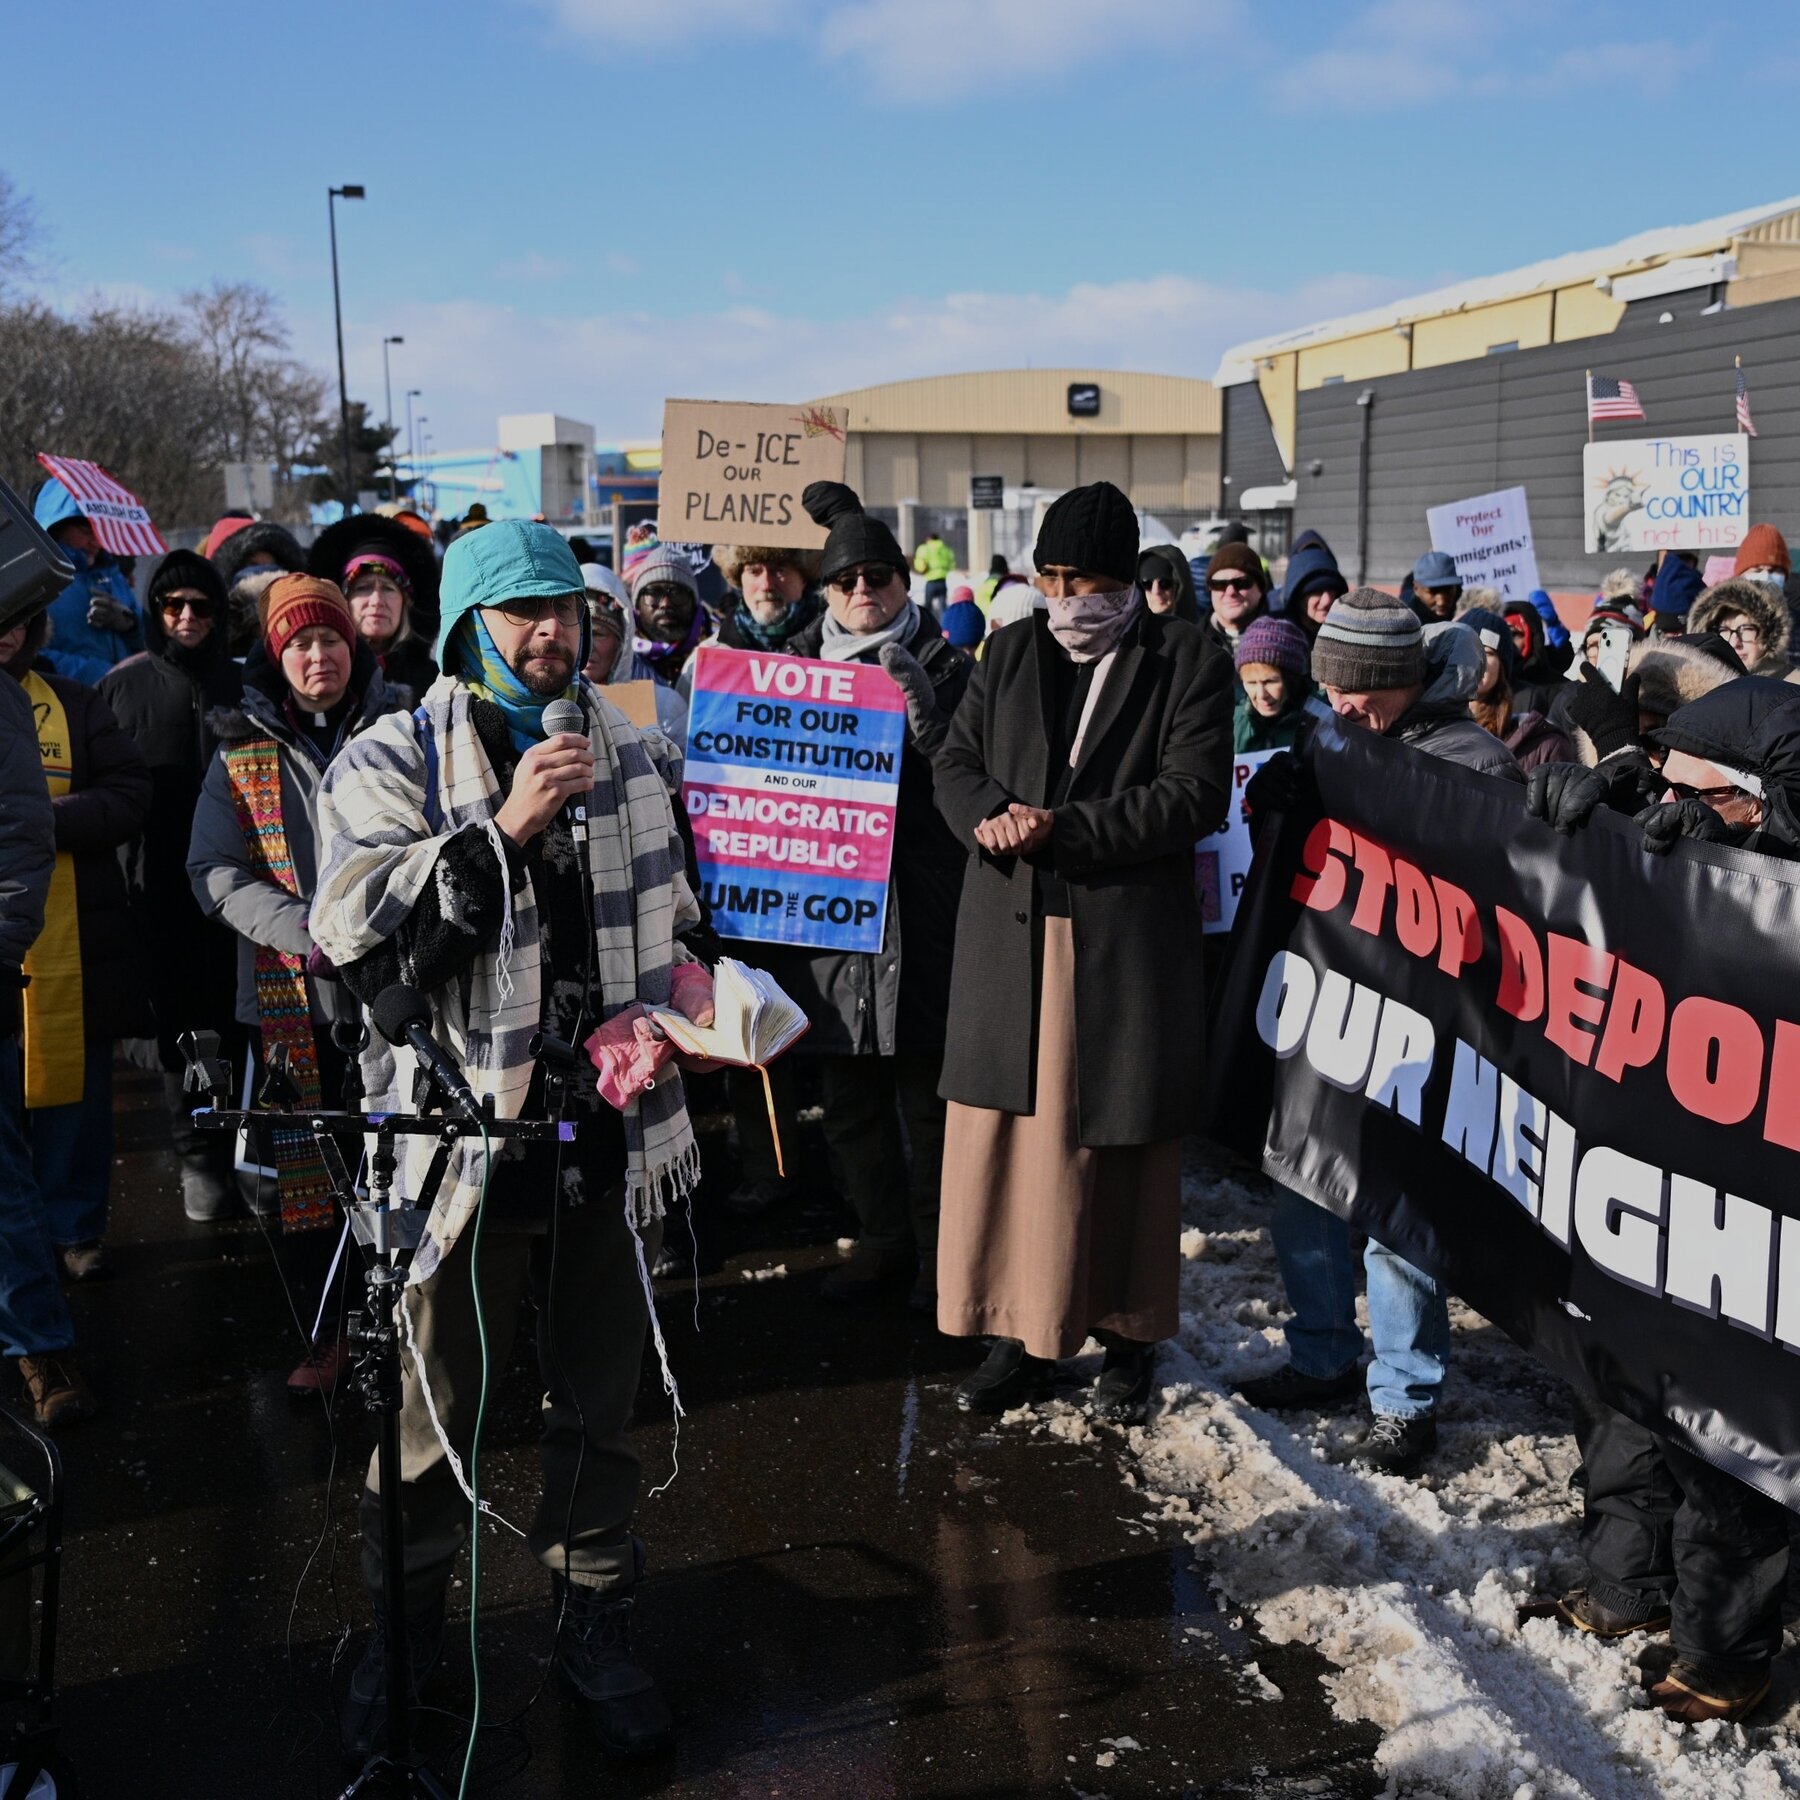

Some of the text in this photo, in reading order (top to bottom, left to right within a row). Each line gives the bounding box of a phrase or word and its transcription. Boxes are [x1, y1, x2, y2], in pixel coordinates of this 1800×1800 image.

[696, 429, 802, 466] De-ICE
[1646, 442, 1700, 467] This
[723, 465, 761, 481] OUR
[1680, 464, 1740, 491] OUR
[85, 502, 145, 521] ABOLISH ICE
[685, 491, 794, 525] PLANES
[1456, 507, 1502, 527] Protect
[1646, 489, 1749, 519] COUNTRY
[1471, 524, 1495, 537] Our
[1643, 521, 1737, 547] not his
[1493, 564, 1517, 579] Just
[749, 658, 855, 702] VOTE
[736, 701, 859, 735] FOR OUR
[693, 731, 894, 774] CONSTITUTION
[764, 774, 817, 790] AND OUR
[687, 790, 889, 837] DEMOCRATIC
[708, 829, 859, 870] REPUBLIC
[703, 882, 878, 926] UMP THE GOP
[1289, 816, 1483, 979] STOP
[1256, 949, 1436, 1128] OUR
